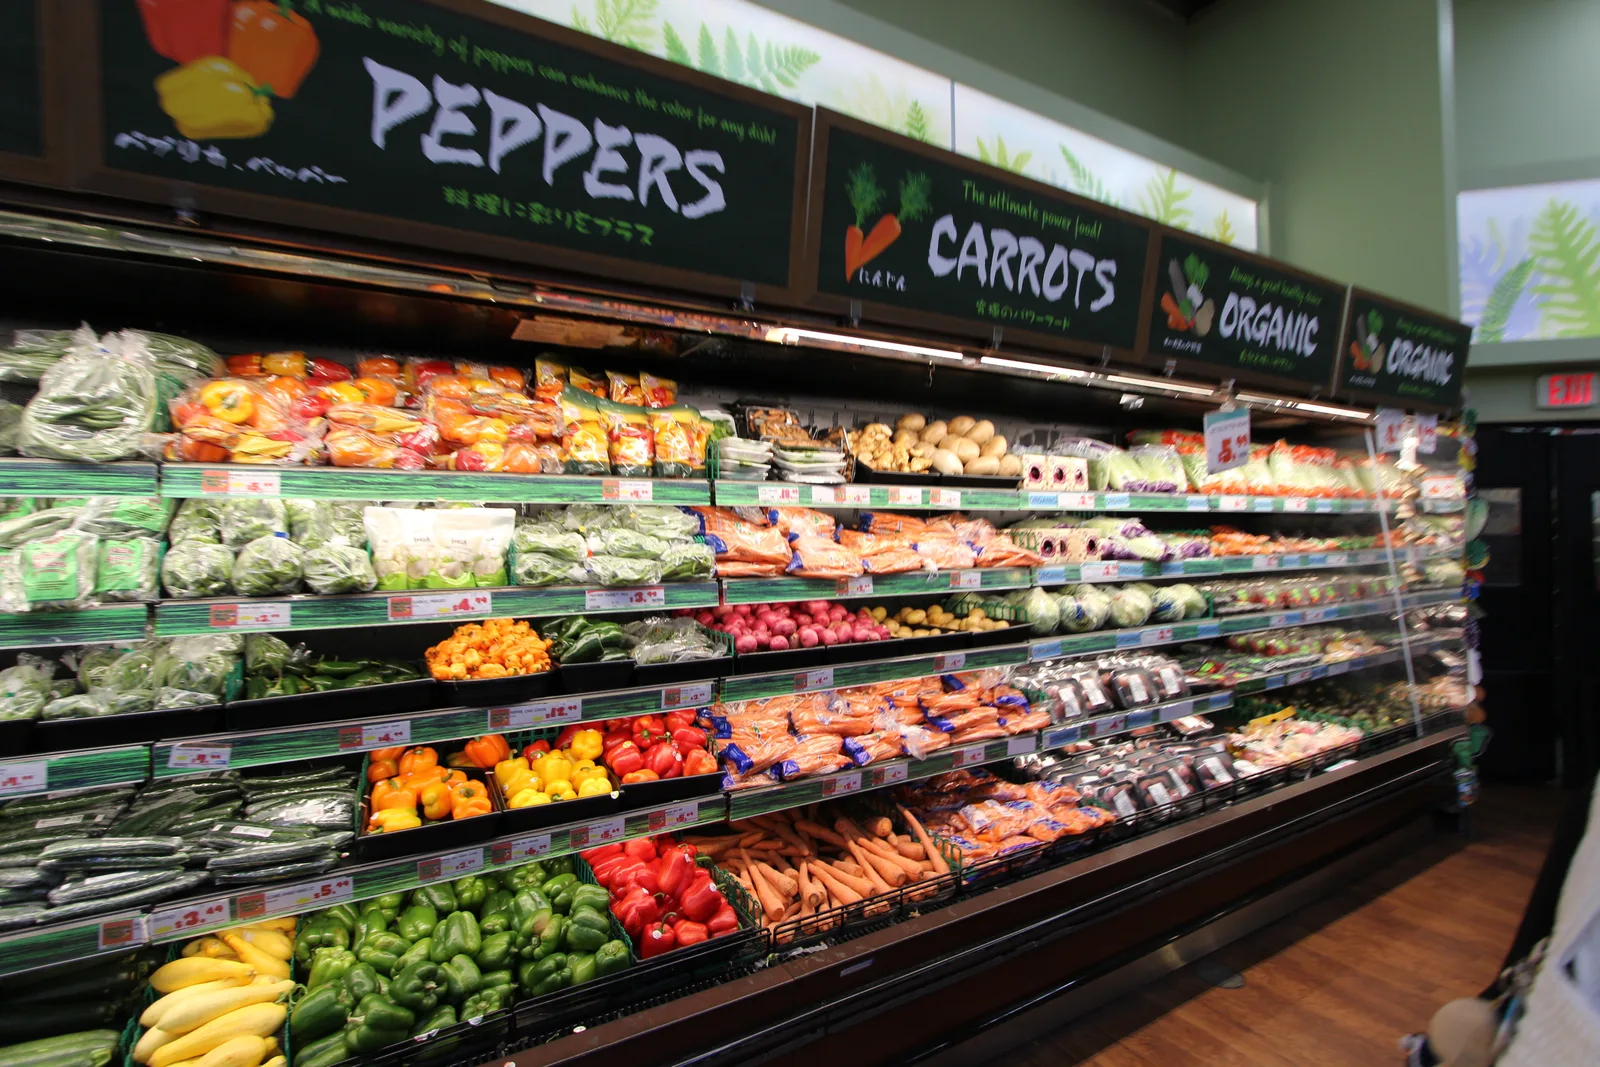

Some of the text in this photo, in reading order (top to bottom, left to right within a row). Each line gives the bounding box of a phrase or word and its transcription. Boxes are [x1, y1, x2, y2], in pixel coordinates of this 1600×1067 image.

[376, 17, 445, 58] variety
[449, 35, 469, 64] of
[473, 44, 535, 77] peppers
[538, 65, 568, 84] can
[571, 73, 632, 104] enhance
[634, 86, 659, 111] the
[662, 100, 694, 121] color
[697, 104, 718, 130] for
[720, 118, 745, 143] any
[362, 56, 727, 220] PEPPERS
[962, 179, 1102, 243] The ultimate power food!
[927, 213, 1117, 313] CARROTS
[1218, 291, 1320, 359] ORGANIC
[1385, 336, 1454, 387] ORGANIC
[175, 904, 224, 929] $3.49
